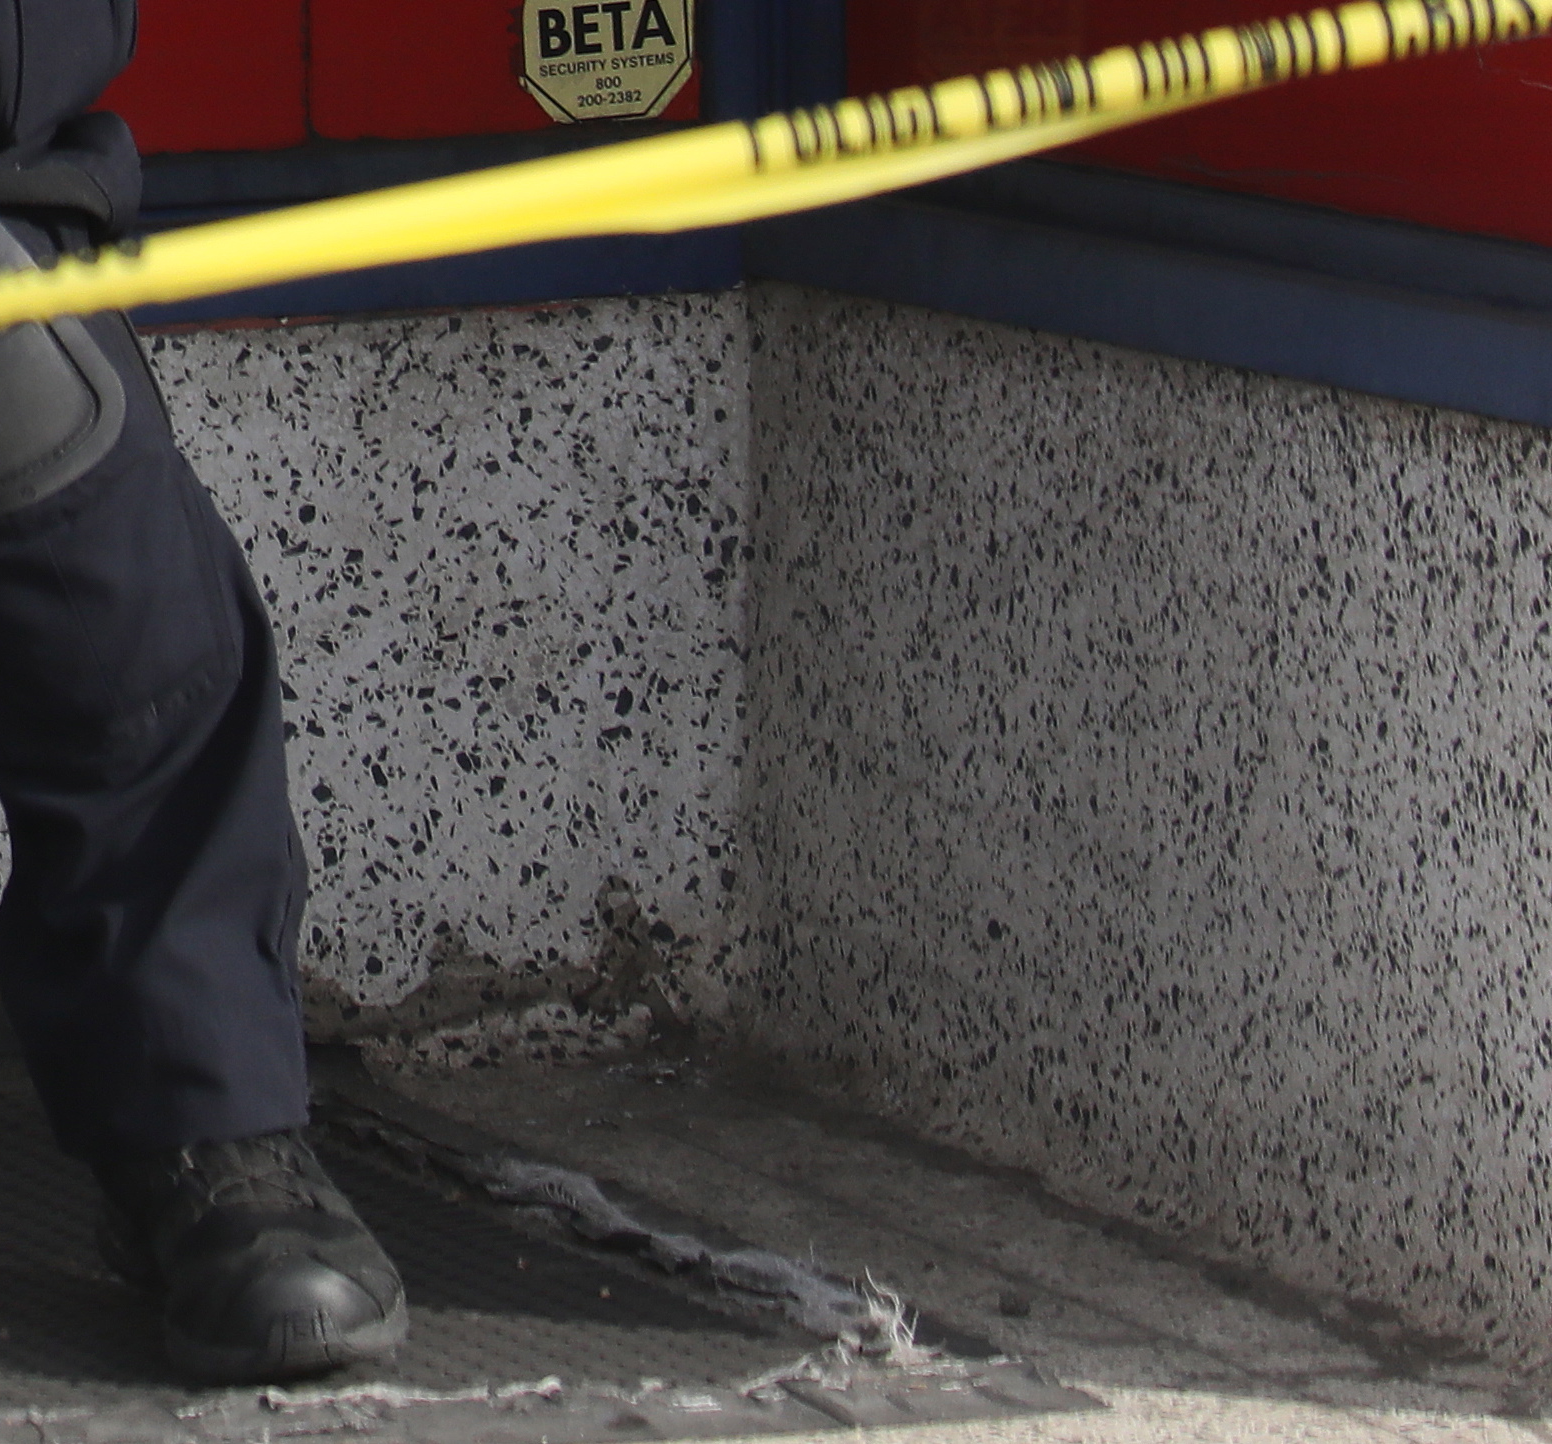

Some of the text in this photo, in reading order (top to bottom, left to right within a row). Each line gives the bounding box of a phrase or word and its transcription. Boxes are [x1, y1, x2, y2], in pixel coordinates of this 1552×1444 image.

[539, 52, 675, 78] SECURITY SYSTEMS
[596, 76, 622, 89] 800
[577, 90, 642, 108] 200-2382
